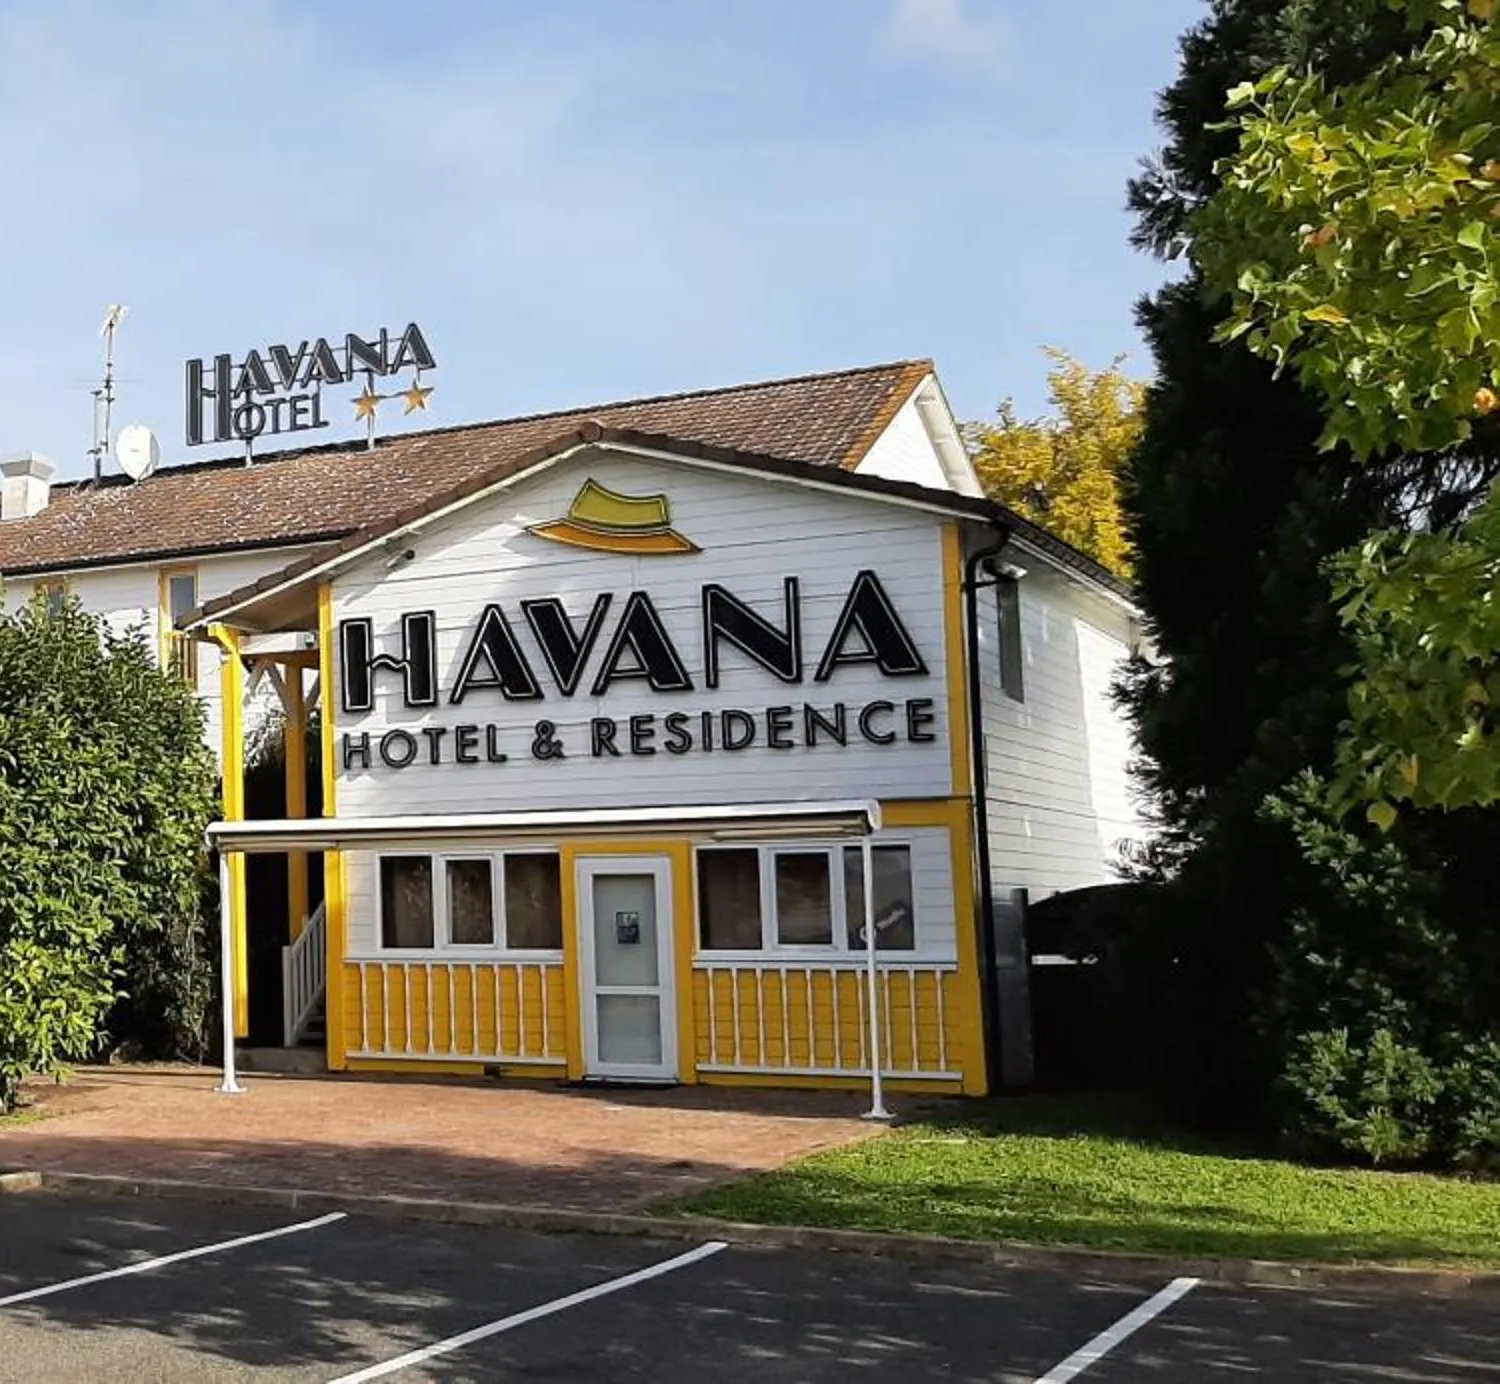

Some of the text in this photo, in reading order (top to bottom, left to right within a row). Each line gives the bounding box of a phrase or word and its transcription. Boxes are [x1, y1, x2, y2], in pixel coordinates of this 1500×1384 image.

[186, 322, 436, 446] HAVANA
[340, 569, 930, 712] HAVANA
[342, 698, 936, 770] HOTEL & RESIDENCE
